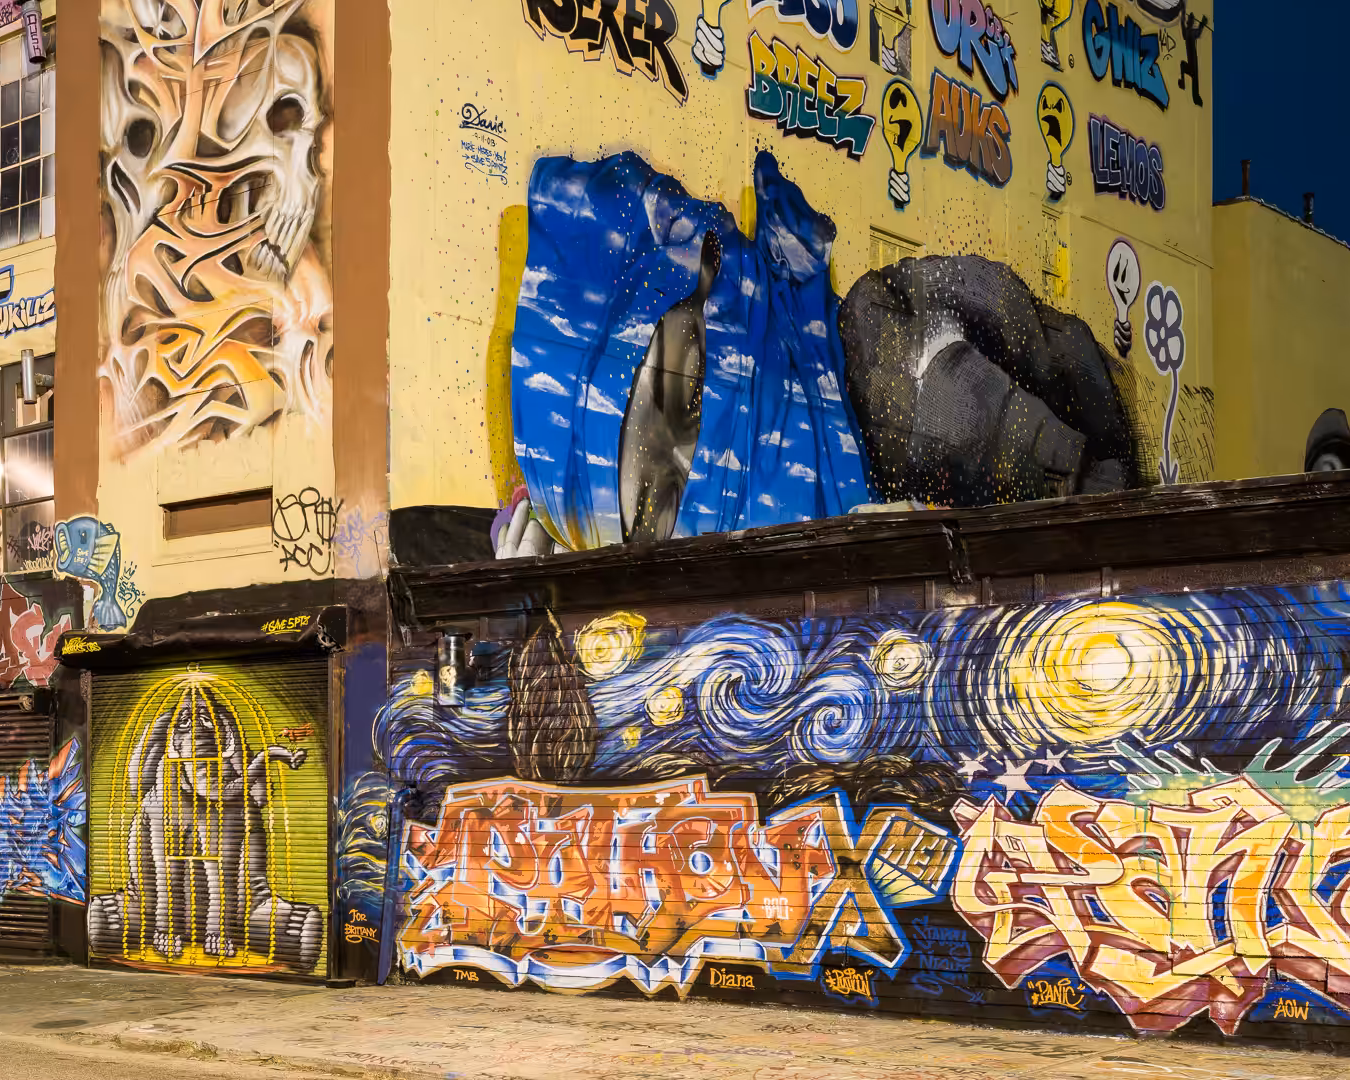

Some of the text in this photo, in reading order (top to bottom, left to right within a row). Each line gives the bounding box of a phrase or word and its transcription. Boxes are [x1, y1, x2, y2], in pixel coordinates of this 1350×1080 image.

[744, 30, 877, 162] BREEZ
[454, 968, 480, 983] TMB
[709, 967, 756, 989] Diana
[1273, 998, 1309, 1020] AOW
